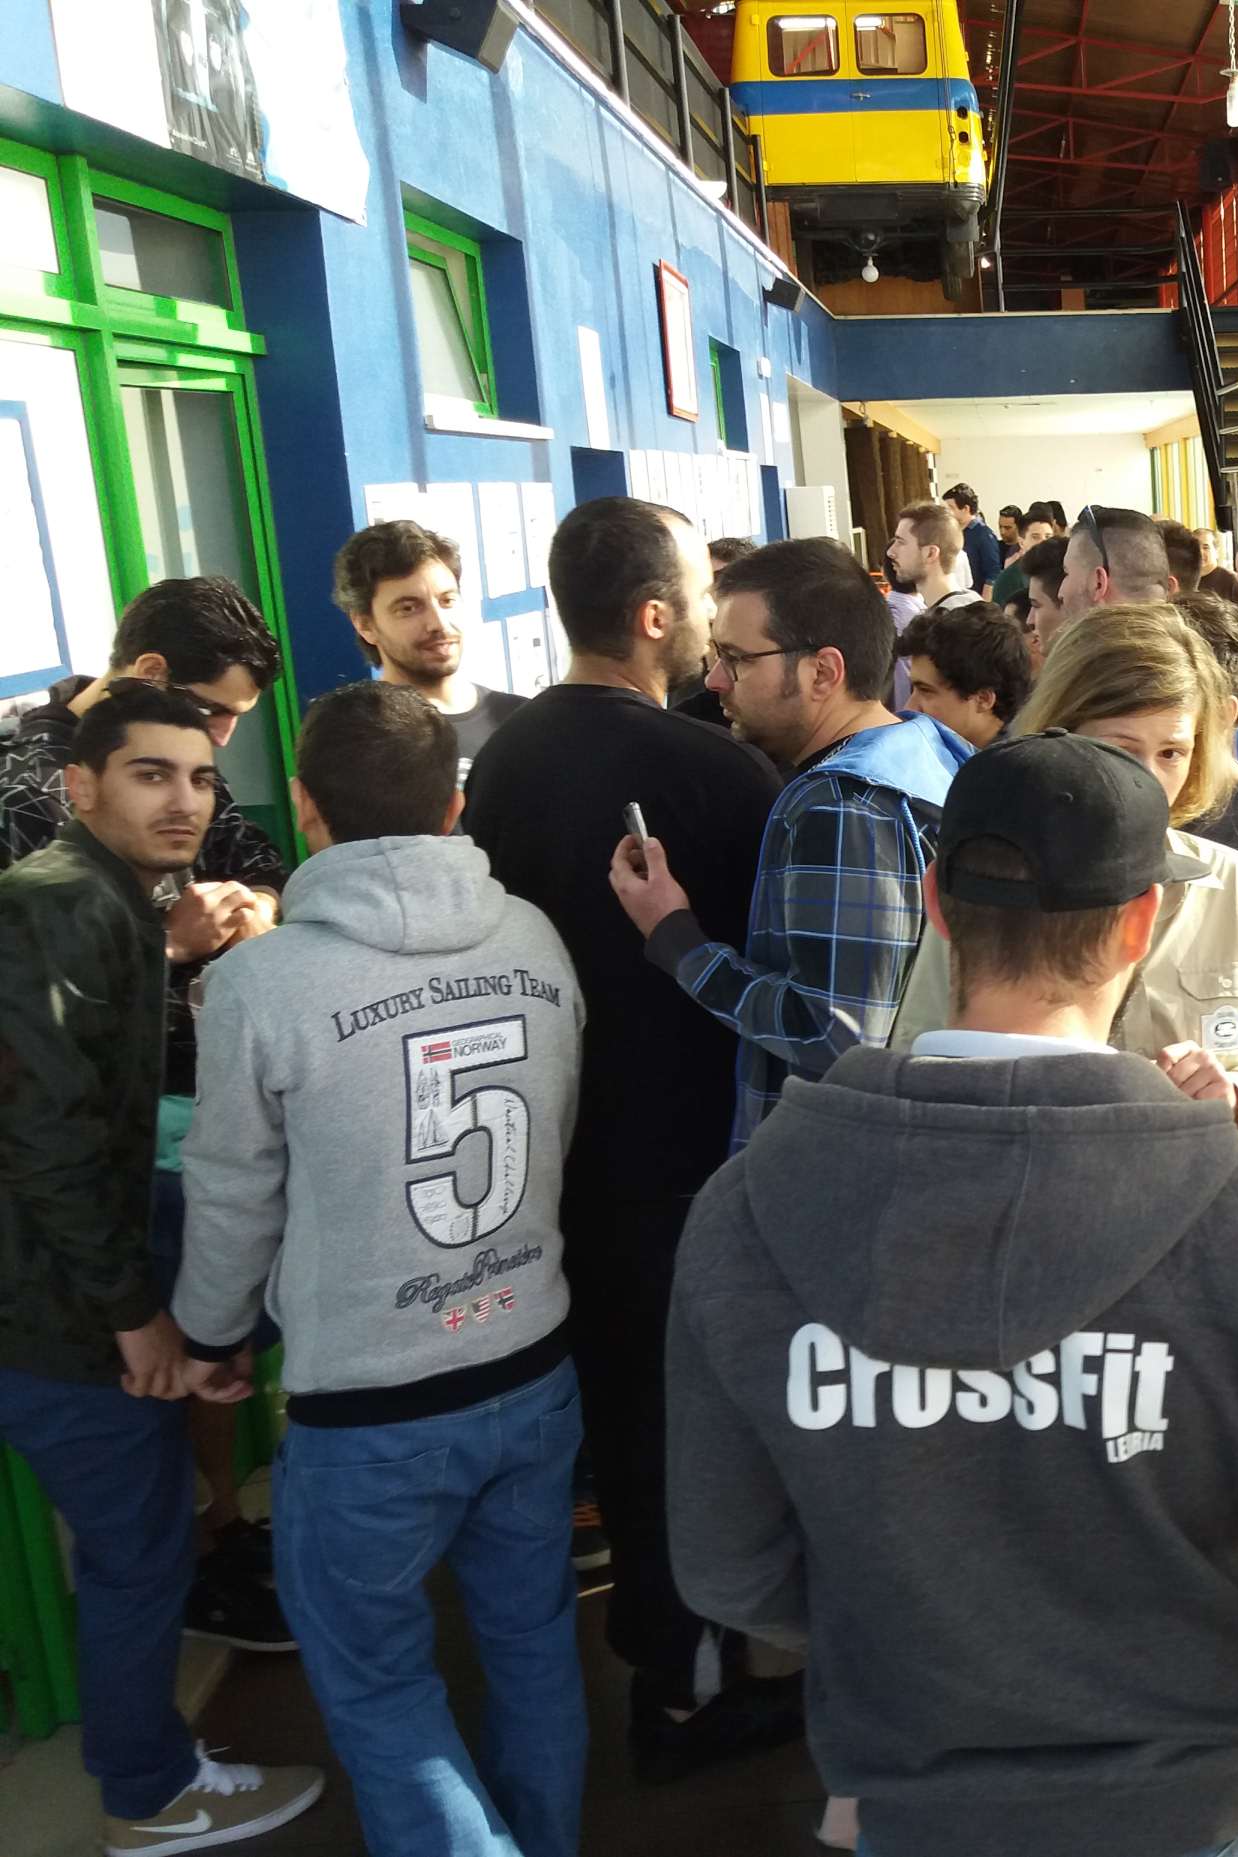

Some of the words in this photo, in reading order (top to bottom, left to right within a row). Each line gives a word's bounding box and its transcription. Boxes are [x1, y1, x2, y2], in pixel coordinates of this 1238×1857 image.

[331, 987, 425, 1042] LUXURY
[428, 976, 512, 1004] SAILING
[514, 968, 560, 1007] TEAM
[453, 1037, 508, 1058] NORWAY
[403, 1014, 529, 1249] 5
